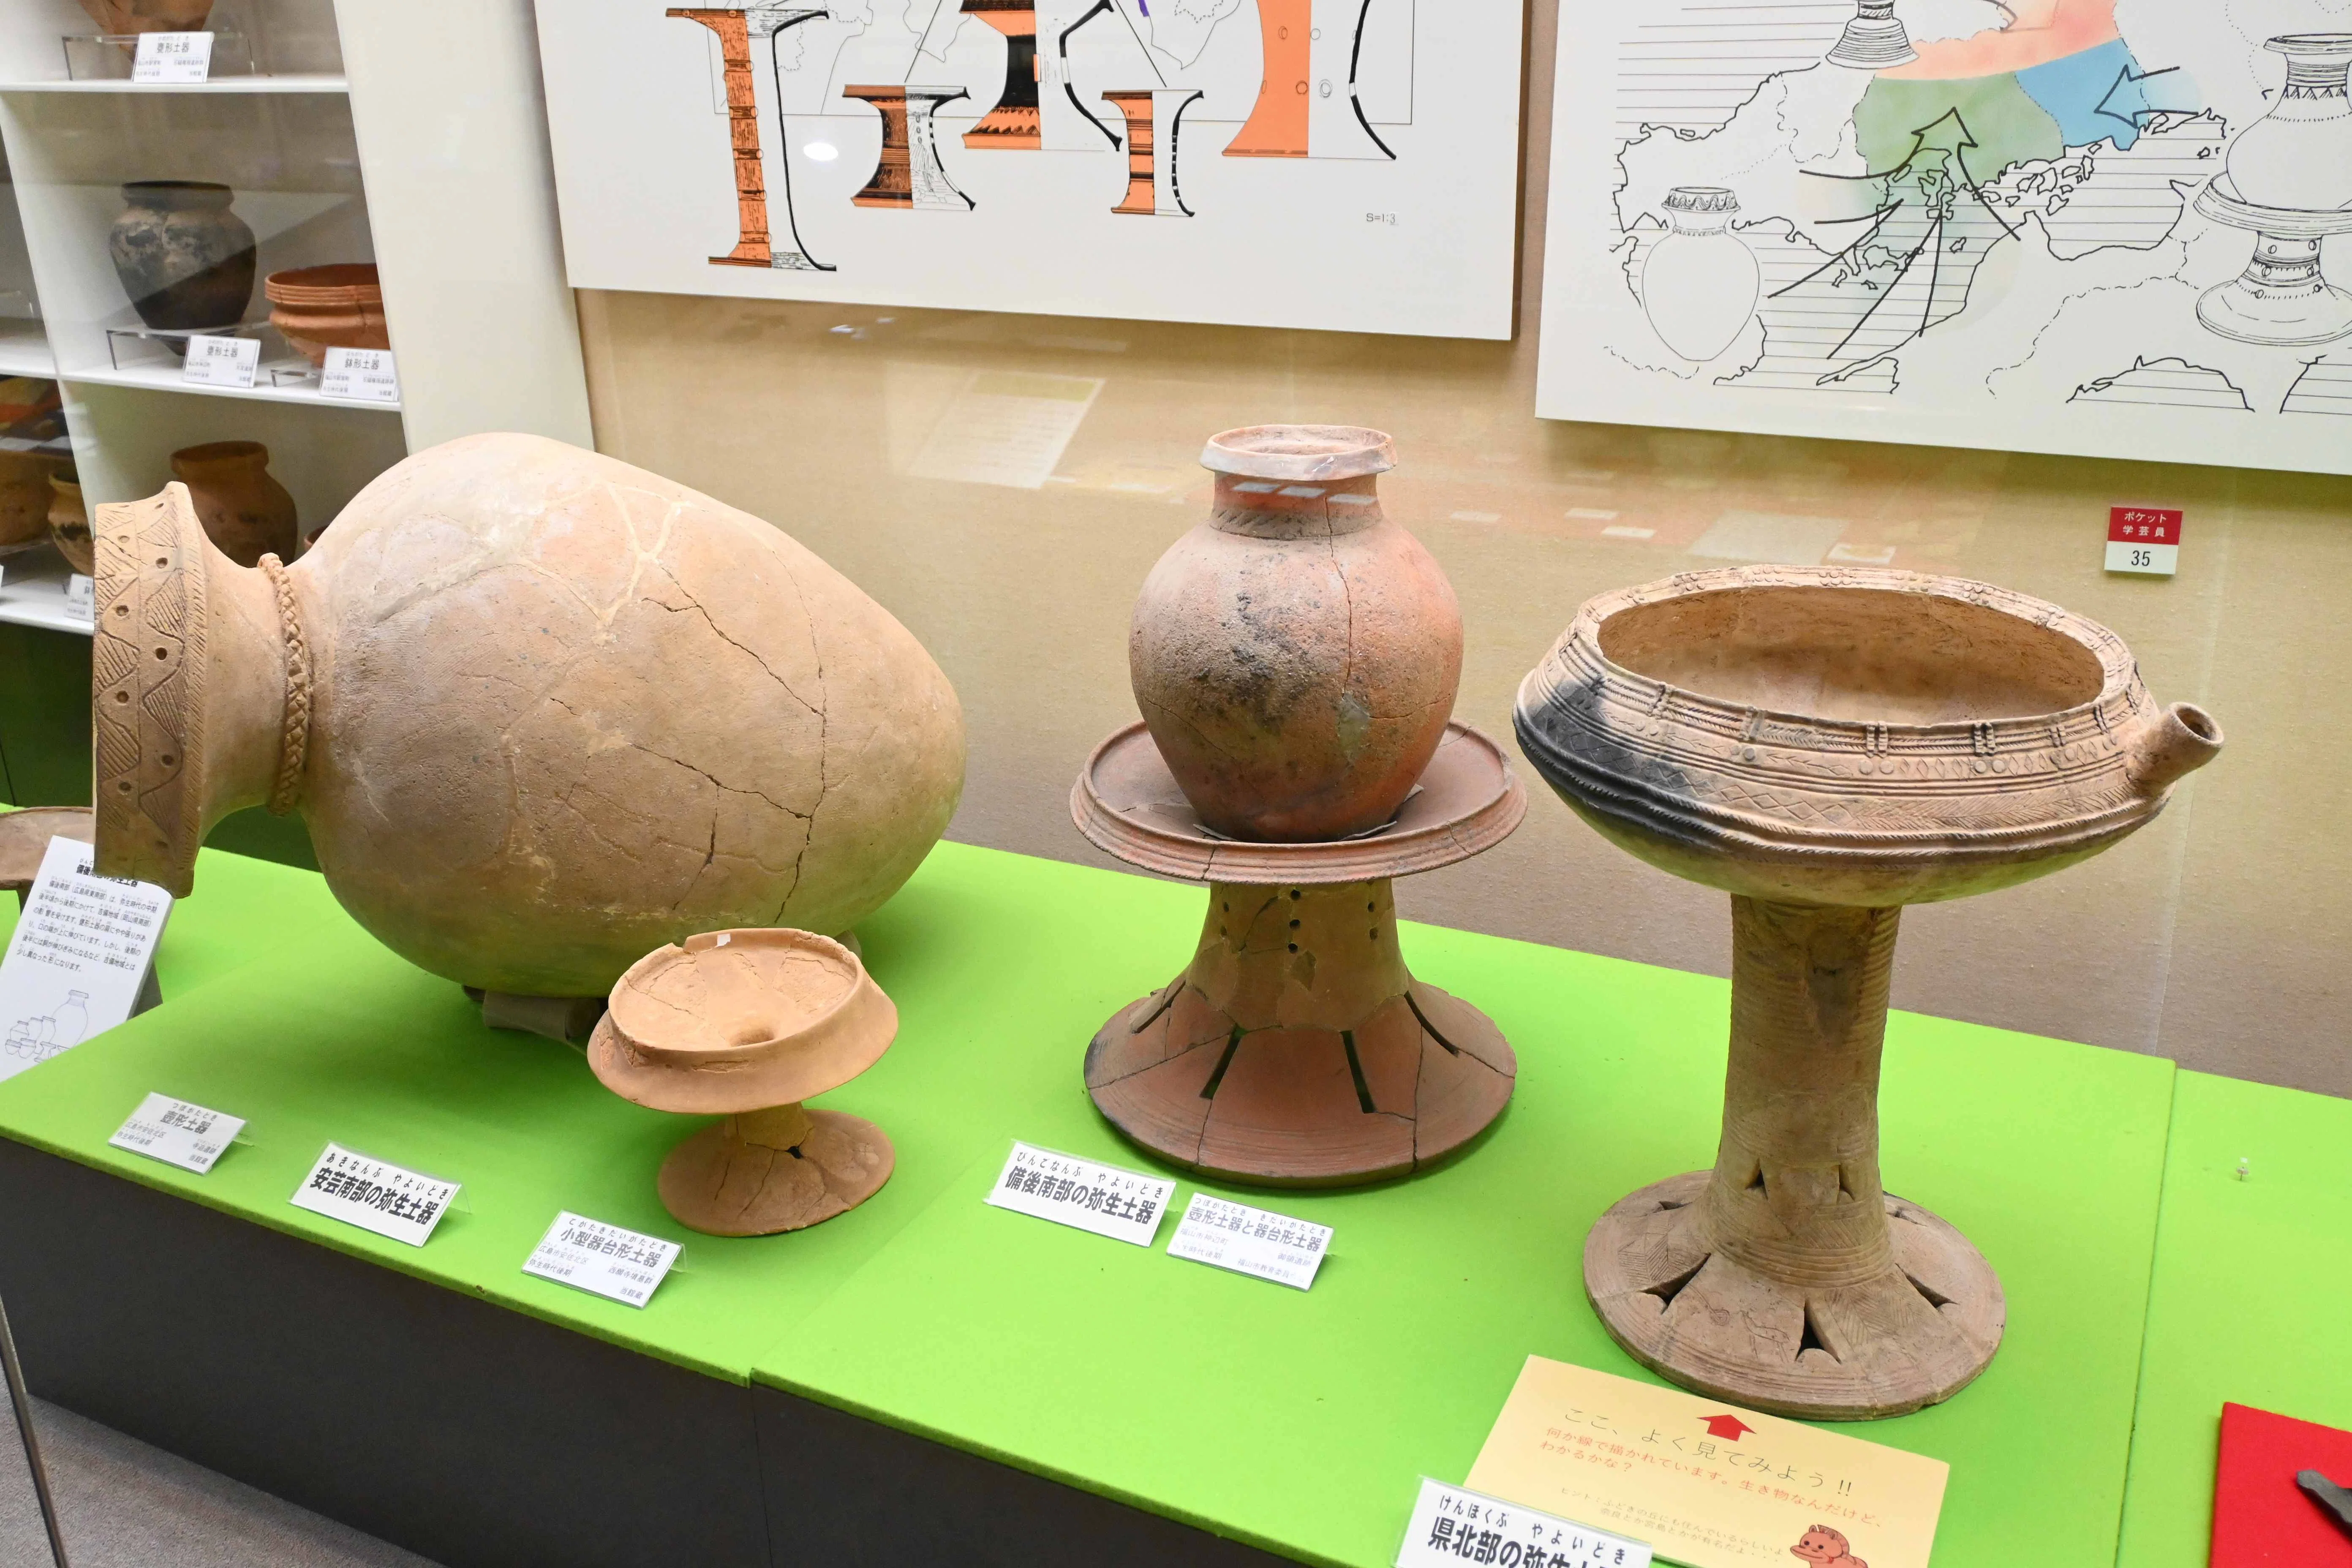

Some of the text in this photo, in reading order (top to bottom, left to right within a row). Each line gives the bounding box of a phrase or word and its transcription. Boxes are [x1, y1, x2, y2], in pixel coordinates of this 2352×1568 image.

[2123, 525, 2165, 537] 学芸員
[2124, 512, 2167, 523] ポケット
[2131, 550, 2151, 566] 35
[160, 1110, 212, 1134] 壺形土器
[310, 1167, 439, 1225] 安芸南部の弥生土器
[327, 1152, 448, 1200] あきなんぶ やよいどき
[1005, 1166, 1157, 1224] 備後南部の弥生土器
[1017, 1152, 1163, 1198] びんごなんぶ やよいどき
[561, 1228, 662, 1268] 小型器台形土器
[1187, 1207, 1322, 1252] 壺形土器と器台形土器
[1541, 1440, 1632, 1472] わかるかな？
[1428, 1516, 1609, 1568] 県北部の弥生
[1439, 1495, 1625, 1565] けんほくぶ やよいどき
